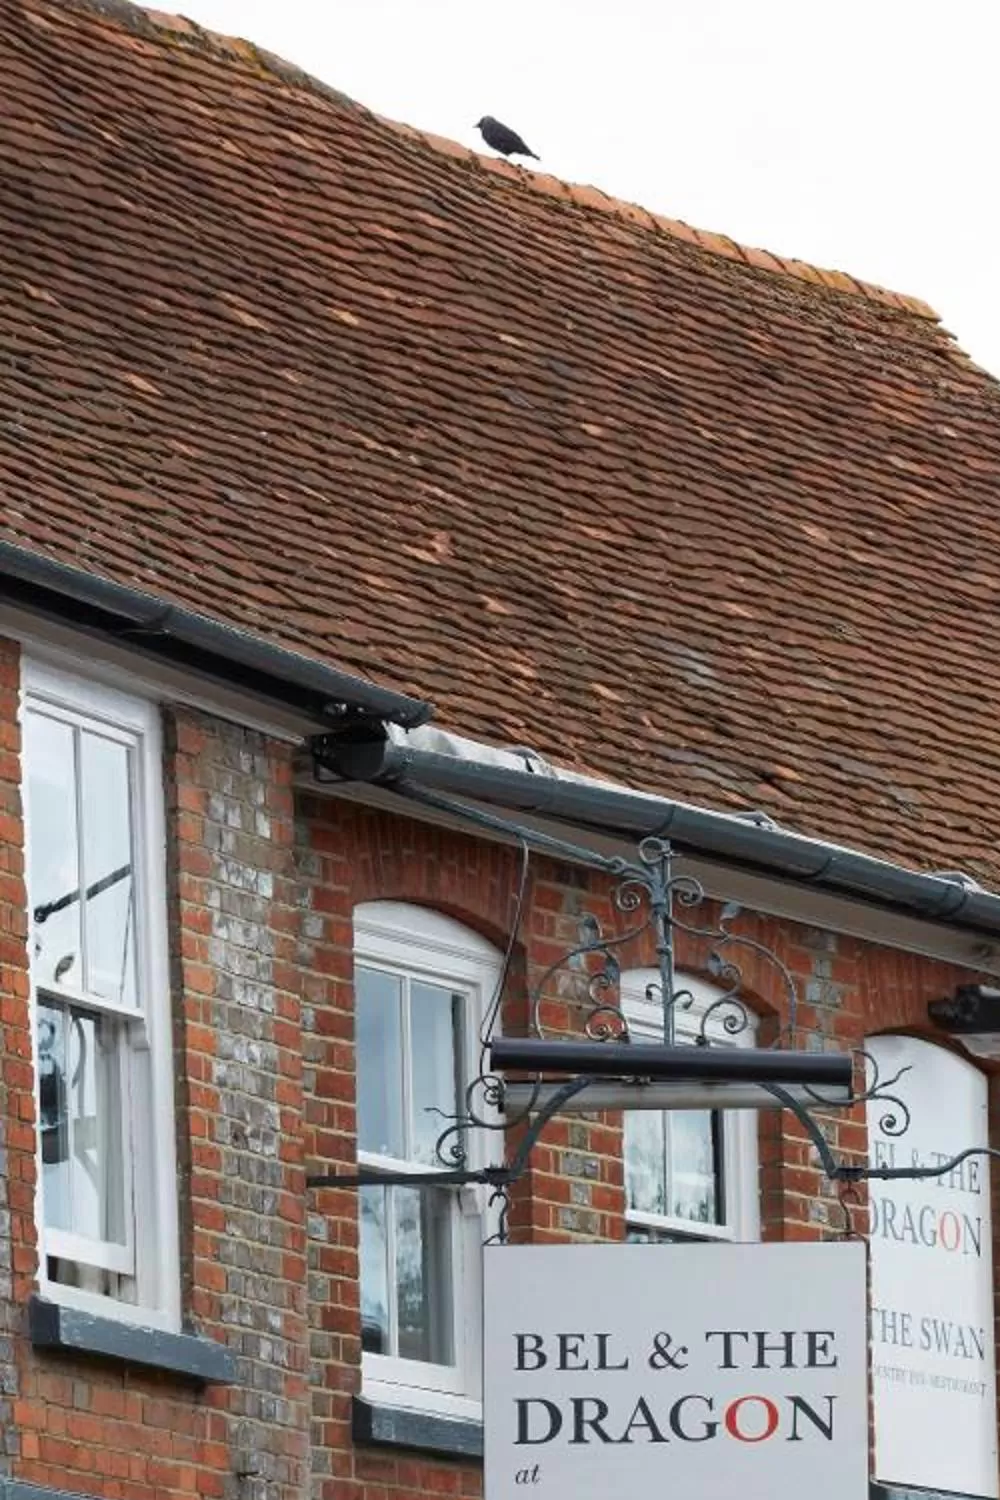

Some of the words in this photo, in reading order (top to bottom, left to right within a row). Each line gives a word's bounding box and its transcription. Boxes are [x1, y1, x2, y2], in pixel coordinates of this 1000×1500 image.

[931, 1151, 981, 1193] THE
[513, 1333, 629, 1371] BEL
[649, 1332, 689, 1370] &
[705, 1331, 838, 1369] THE
[920, 1317, 985, 1360] SWAN
[512, 1395, 837, 1445] DRAGON
[515, 1464, 540, 1485] at
